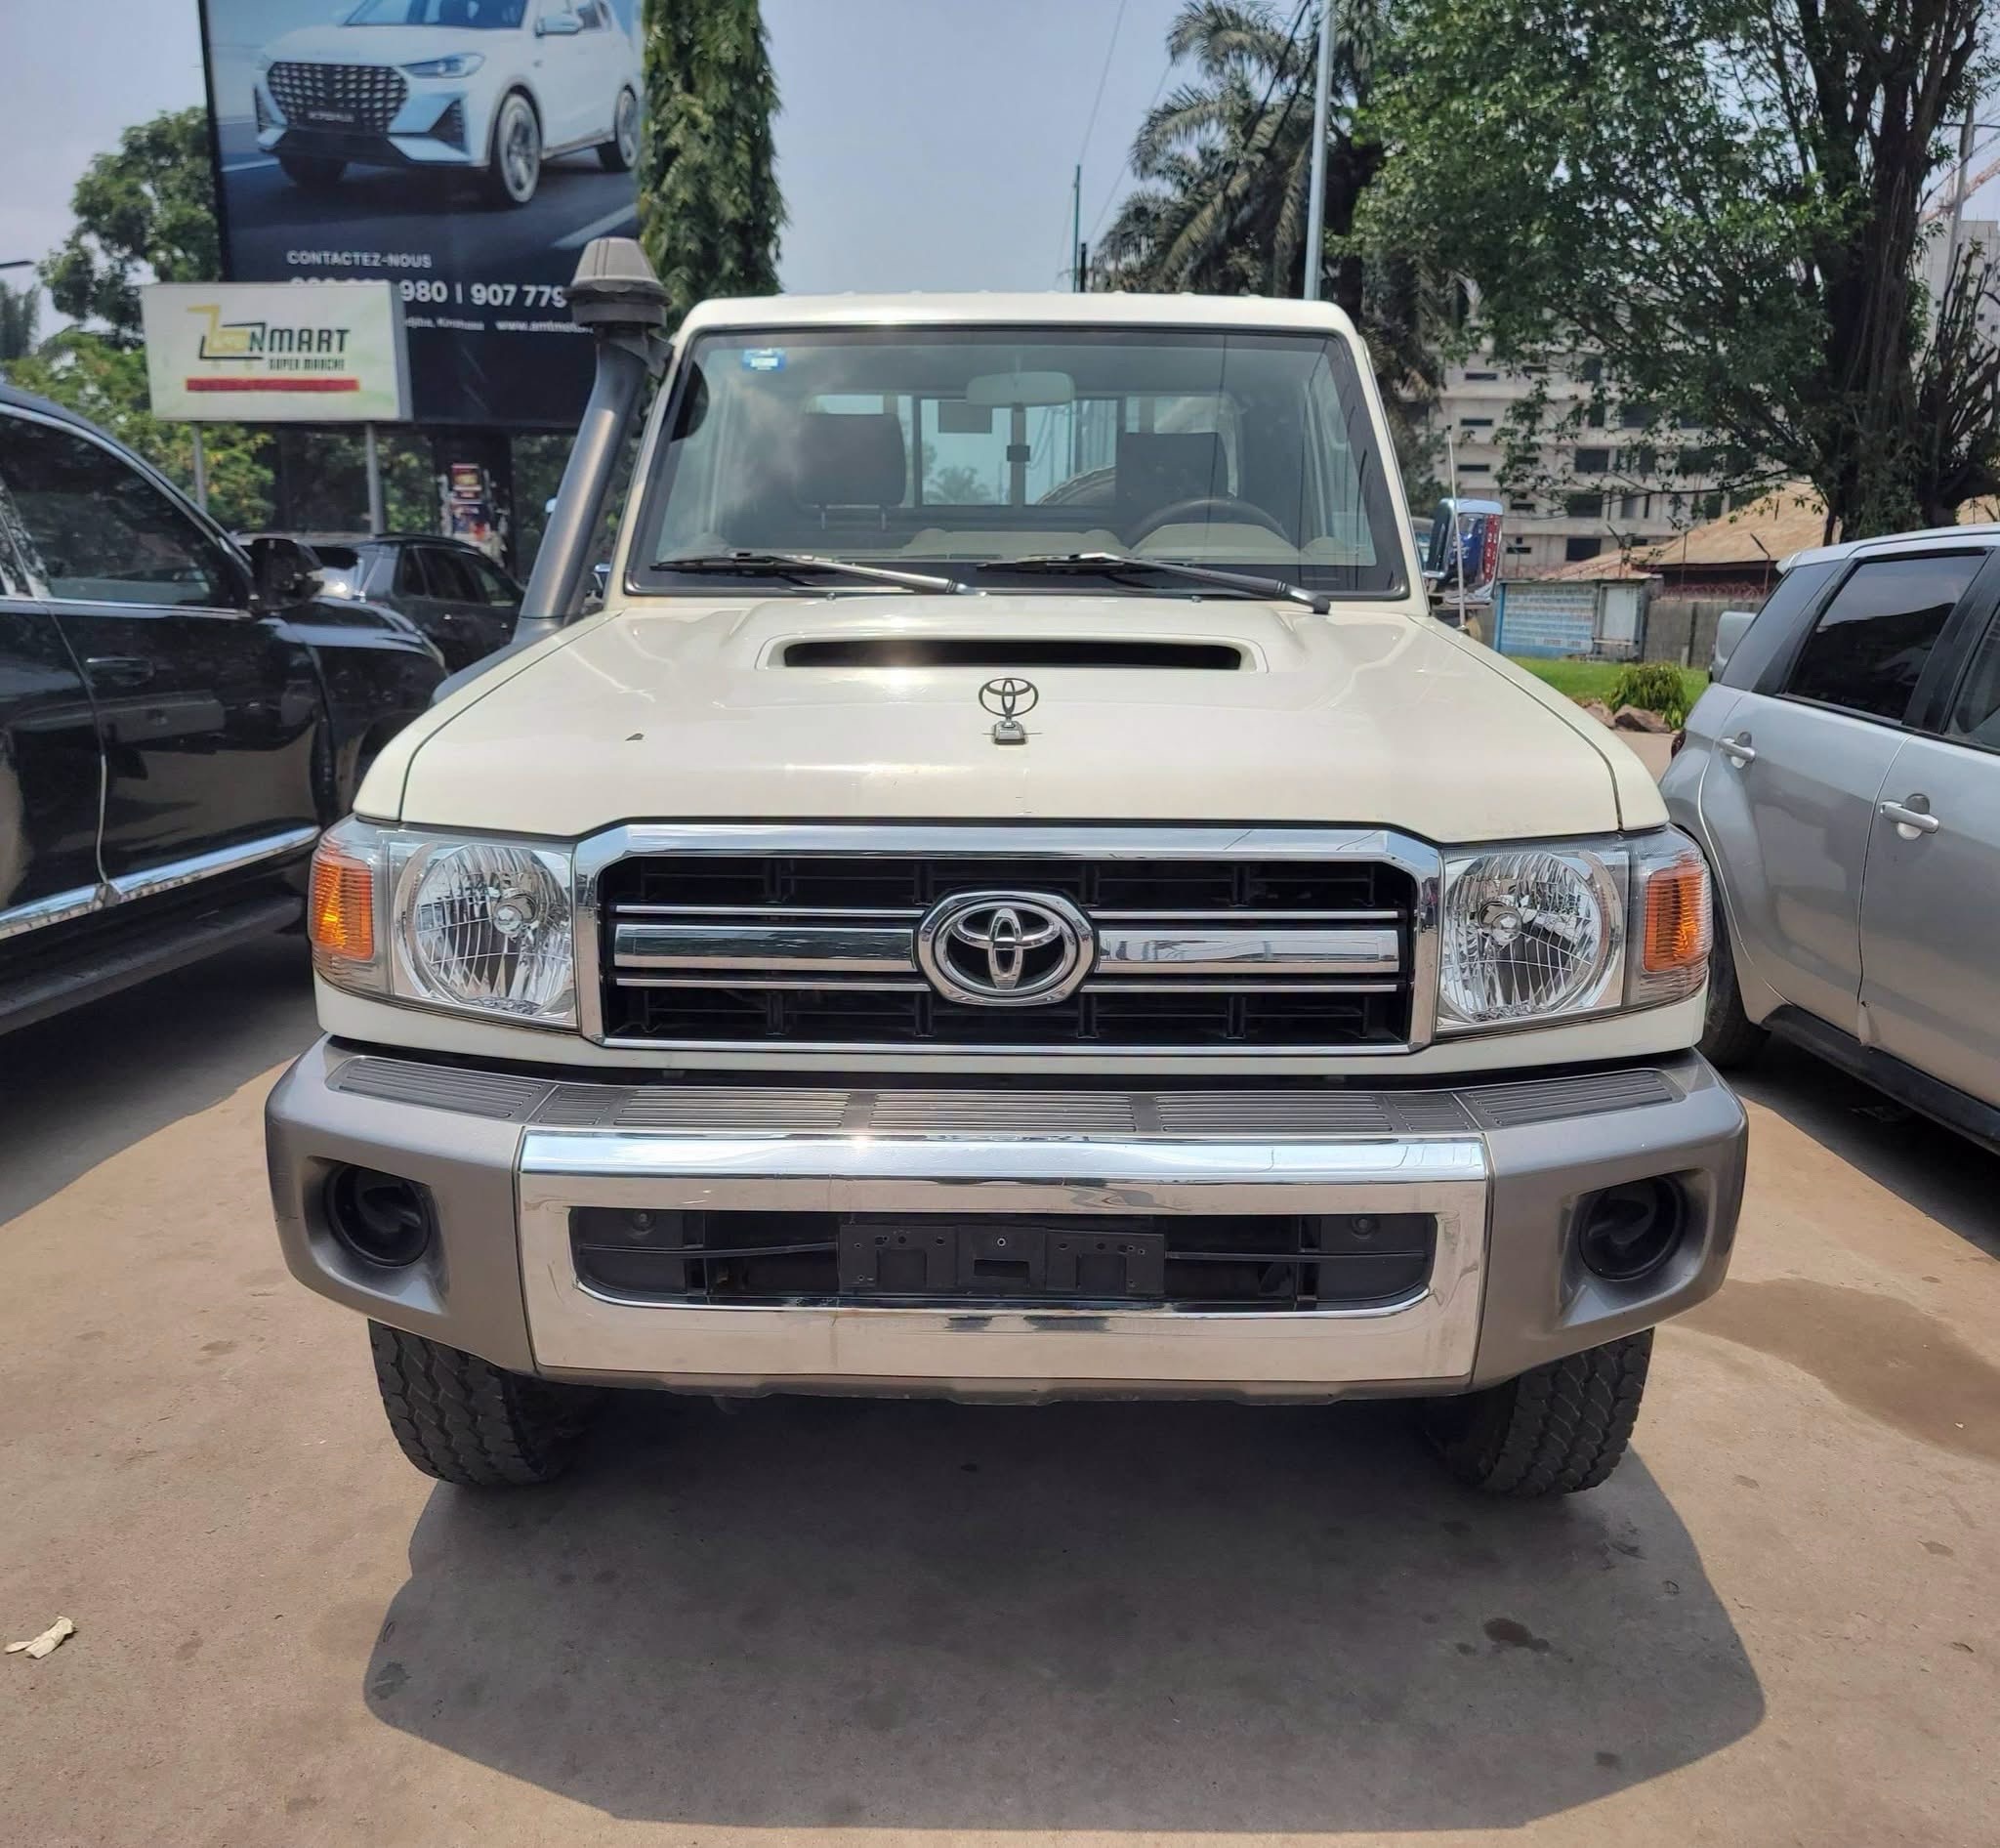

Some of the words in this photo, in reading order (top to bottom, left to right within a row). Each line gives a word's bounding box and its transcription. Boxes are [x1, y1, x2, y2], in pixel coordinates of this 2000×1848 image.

[286, 250, 433, 269] CONTACTEZ-NOUS
[398, 279, 448, 303] 980
[470, 282, 518, 307] 907
